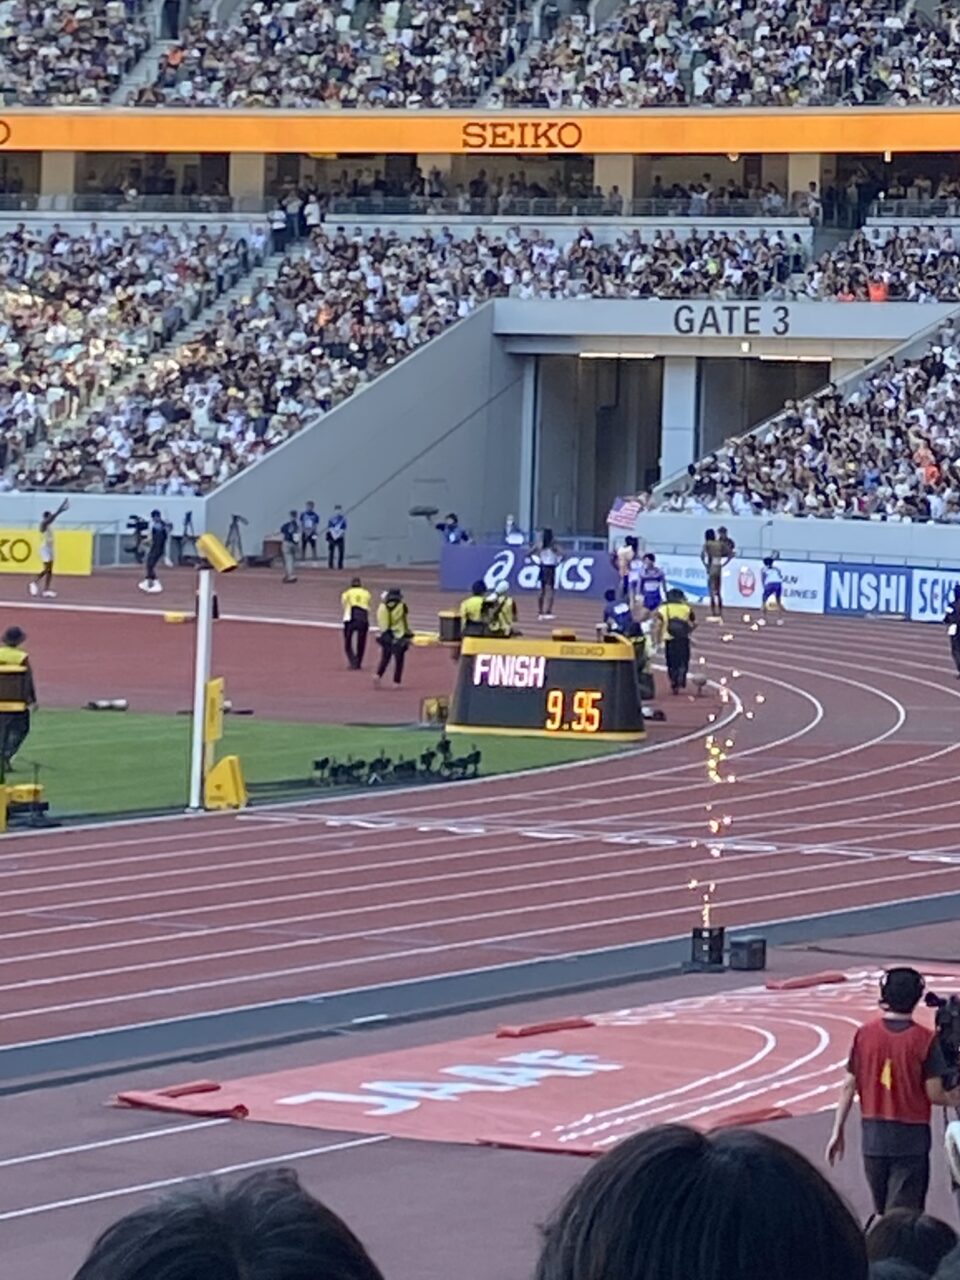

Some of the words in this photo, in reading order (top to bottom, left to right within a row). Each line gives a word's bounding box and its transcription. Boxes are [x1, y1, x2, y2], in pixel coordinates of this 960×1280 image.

[462, 122, 582, 148] SEIKO
[674, 305, 761, 335] GATE
[773, 306, 790, 336] 3
[829, 570, 907, 614] NISHI
[473, 654, 546, 688] FINISH
[545, 689, 602, 733] 9.95
